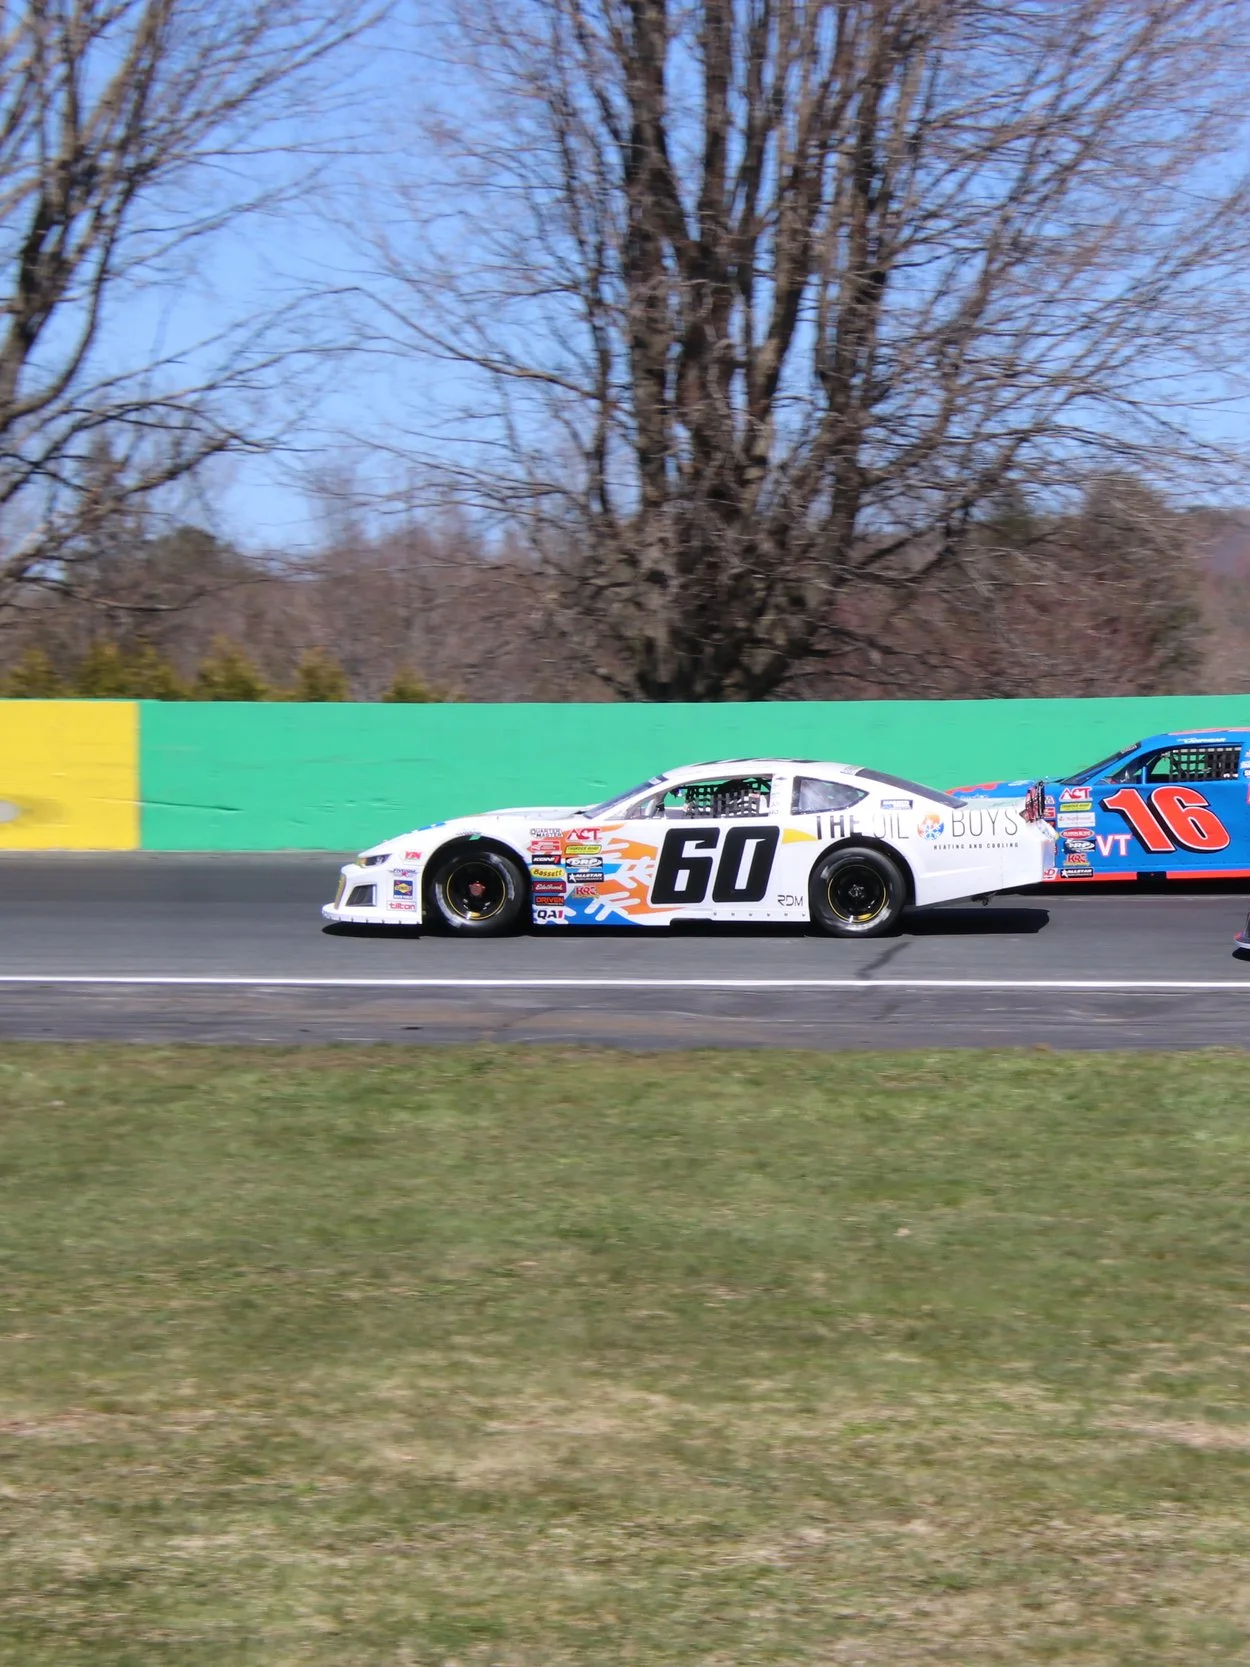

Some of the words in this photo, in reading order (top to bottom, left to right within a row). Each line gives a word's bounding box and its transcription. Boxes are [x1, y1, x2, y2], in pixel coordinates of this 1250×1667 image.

[1061, 787, 1091, 799] ACT
[952, 808, 1018, 837] BOYS
[1103, 786, 1230, 851] 16
[567, 828, 600, 840] ACT
[1096, 834, 1132, 856] VT
[651, 826, 780, 904] 60
[534, 868, 562, 877] Bassett
[777, 895, 804, 907] RDM
[537, 910, 563, 919] QA1
